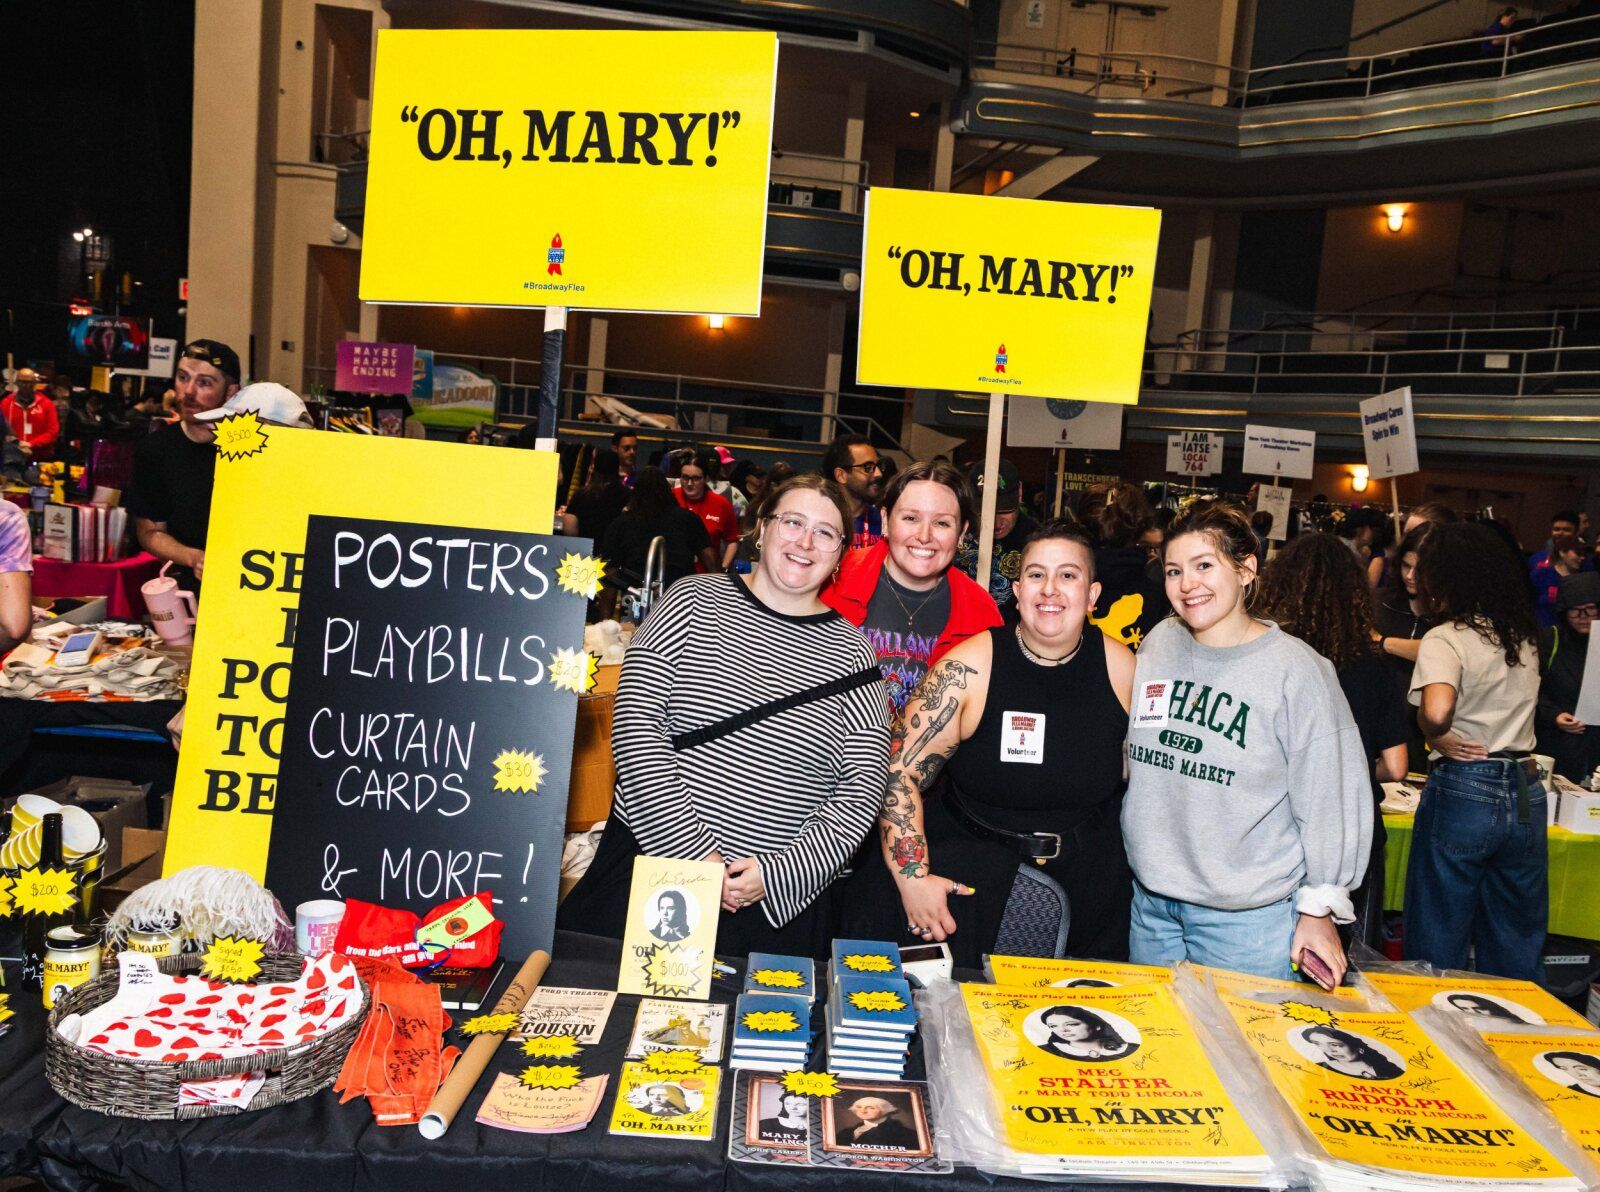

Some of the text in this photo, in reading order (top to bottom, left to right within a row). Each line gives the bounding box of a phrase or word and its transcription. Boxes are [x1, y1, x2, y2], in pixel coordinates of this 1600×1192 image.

[522, 109, 741, 168] MARY!”
[977, 254, 1134, 304] MARY!”
[523, 281, 586, 293] #BroadwayFlea
[353, 346, 398, 358] MAYBE
[353, 357, 397, 367] HAPPY
[352, 366, 397, 378] ENDING
[977, 376, 1022, 386] #BroadwayFlea
[1364, 407, 1404, 426] Broadway Cares
[1184, 431, 1209, 443] I AM
[1182, 442, 1211, 454] IATSE
[1182, 453, 1208, 463] LOCAL
[1184, 461, 1204, 472] 764
[1065, 482, 1084, 491] LOVE
[333, 531, 550, 600] POSTERS
[322, 616, 547, 686] PLAYBILLS
[308, 706, 476, 771] CURTAIN
[1164, 731, 1198, 753] 1973
[1007, 747, 1037, 757] Volunteer
[1128, 743, 1236, 787] FARMERS MARKET
[335, 766, 471, 817] CARDS
[320, 842, 359, 899] &
[30, 883, 60, 897] $200
[345, 945, 367, 956] from
[368, 946, 382, 957] the
[382, 944, 403, 956] dark
[454, 940, 476, 950] mind
[402, 954, 417, 965] am
[1021, 963, 1060, 972] Greatest
[1063, 967, 1084, 976] Play
[1116, 970, 1170, 980] Generation!
[996, 991, 1038, 1000] Greatest
[1041, 993, 1063, 1001] Play
[1098, 991, 1158, 1001] Generation!
[521, 1021, 597, 1036] COUSIN
[1487, 1037, 1529, 1045] Greatest
[1531, 1040, 1556, 1048] Play
[534, 1070, 563, 1081] $20
[796, 1077, 824, 1089] $50
[1038, 1077, 1173, 1089] STALTER
[503, 1092, 532, 1100] Who
[1036, 1089, 1081, 1097] MARY
[1087, 1090, 1131, 1098] TODD
[1136, 1090, 1204, 1098] LINCOLN
[1350, 1084, 1409, 1097] MAYA
[1317, 1087, 1459, 1112] RUDOLPH
[1091, 1106, 1224, 1126] MARY!”
[1326, 1101, 1370, 1113] MARY
[1377, 1106, 1419, 1117] TODD
[1422, 1110, 1488, 1120] LINCOLN
[1396, 1116, 1416, 1126] in
[761, 1131, 802, 1140] MARY
[1388, 1122, 1517, 1148] MARY!”
[774, 1148, 810, 1157] CAMERO
[850, 1143, 907, 1152] MOTHER
[835, 1153, 925, 1163] GEORGE WASHINGTON
